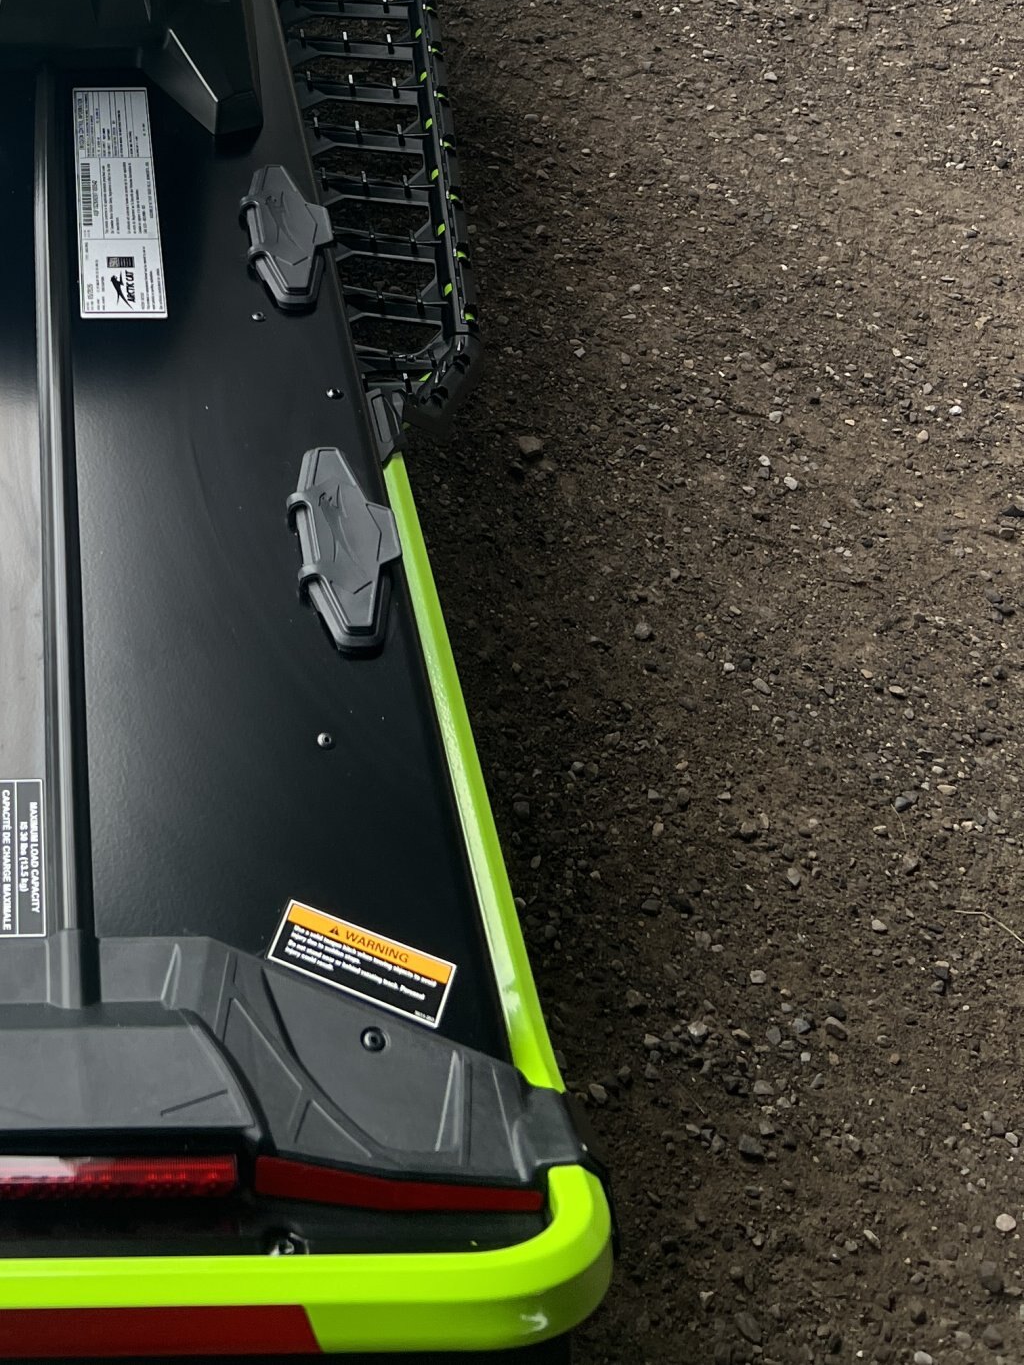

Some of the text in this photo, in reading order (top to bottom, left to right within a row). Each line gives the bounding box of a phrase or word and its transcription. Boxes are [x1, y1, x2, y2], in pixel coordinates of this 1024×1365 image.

[125, 270, 136, 303] ARCTIC CAT
[2, 831, 10, 844] DE
[19, 821, 27, 830] IS
[20, 842, 28, 855] lbs
[29, 801, 40, 912] MAXIMUM LOAD CAPACITY
[2, 845, 10, 882] CHARGE
[18, 856, 28, 877] (13.5
[19, 877, 28, 892] kg)
[2, 883, 11, 930] MAXIMALE
[344, 930, 410, 964] WARNING
